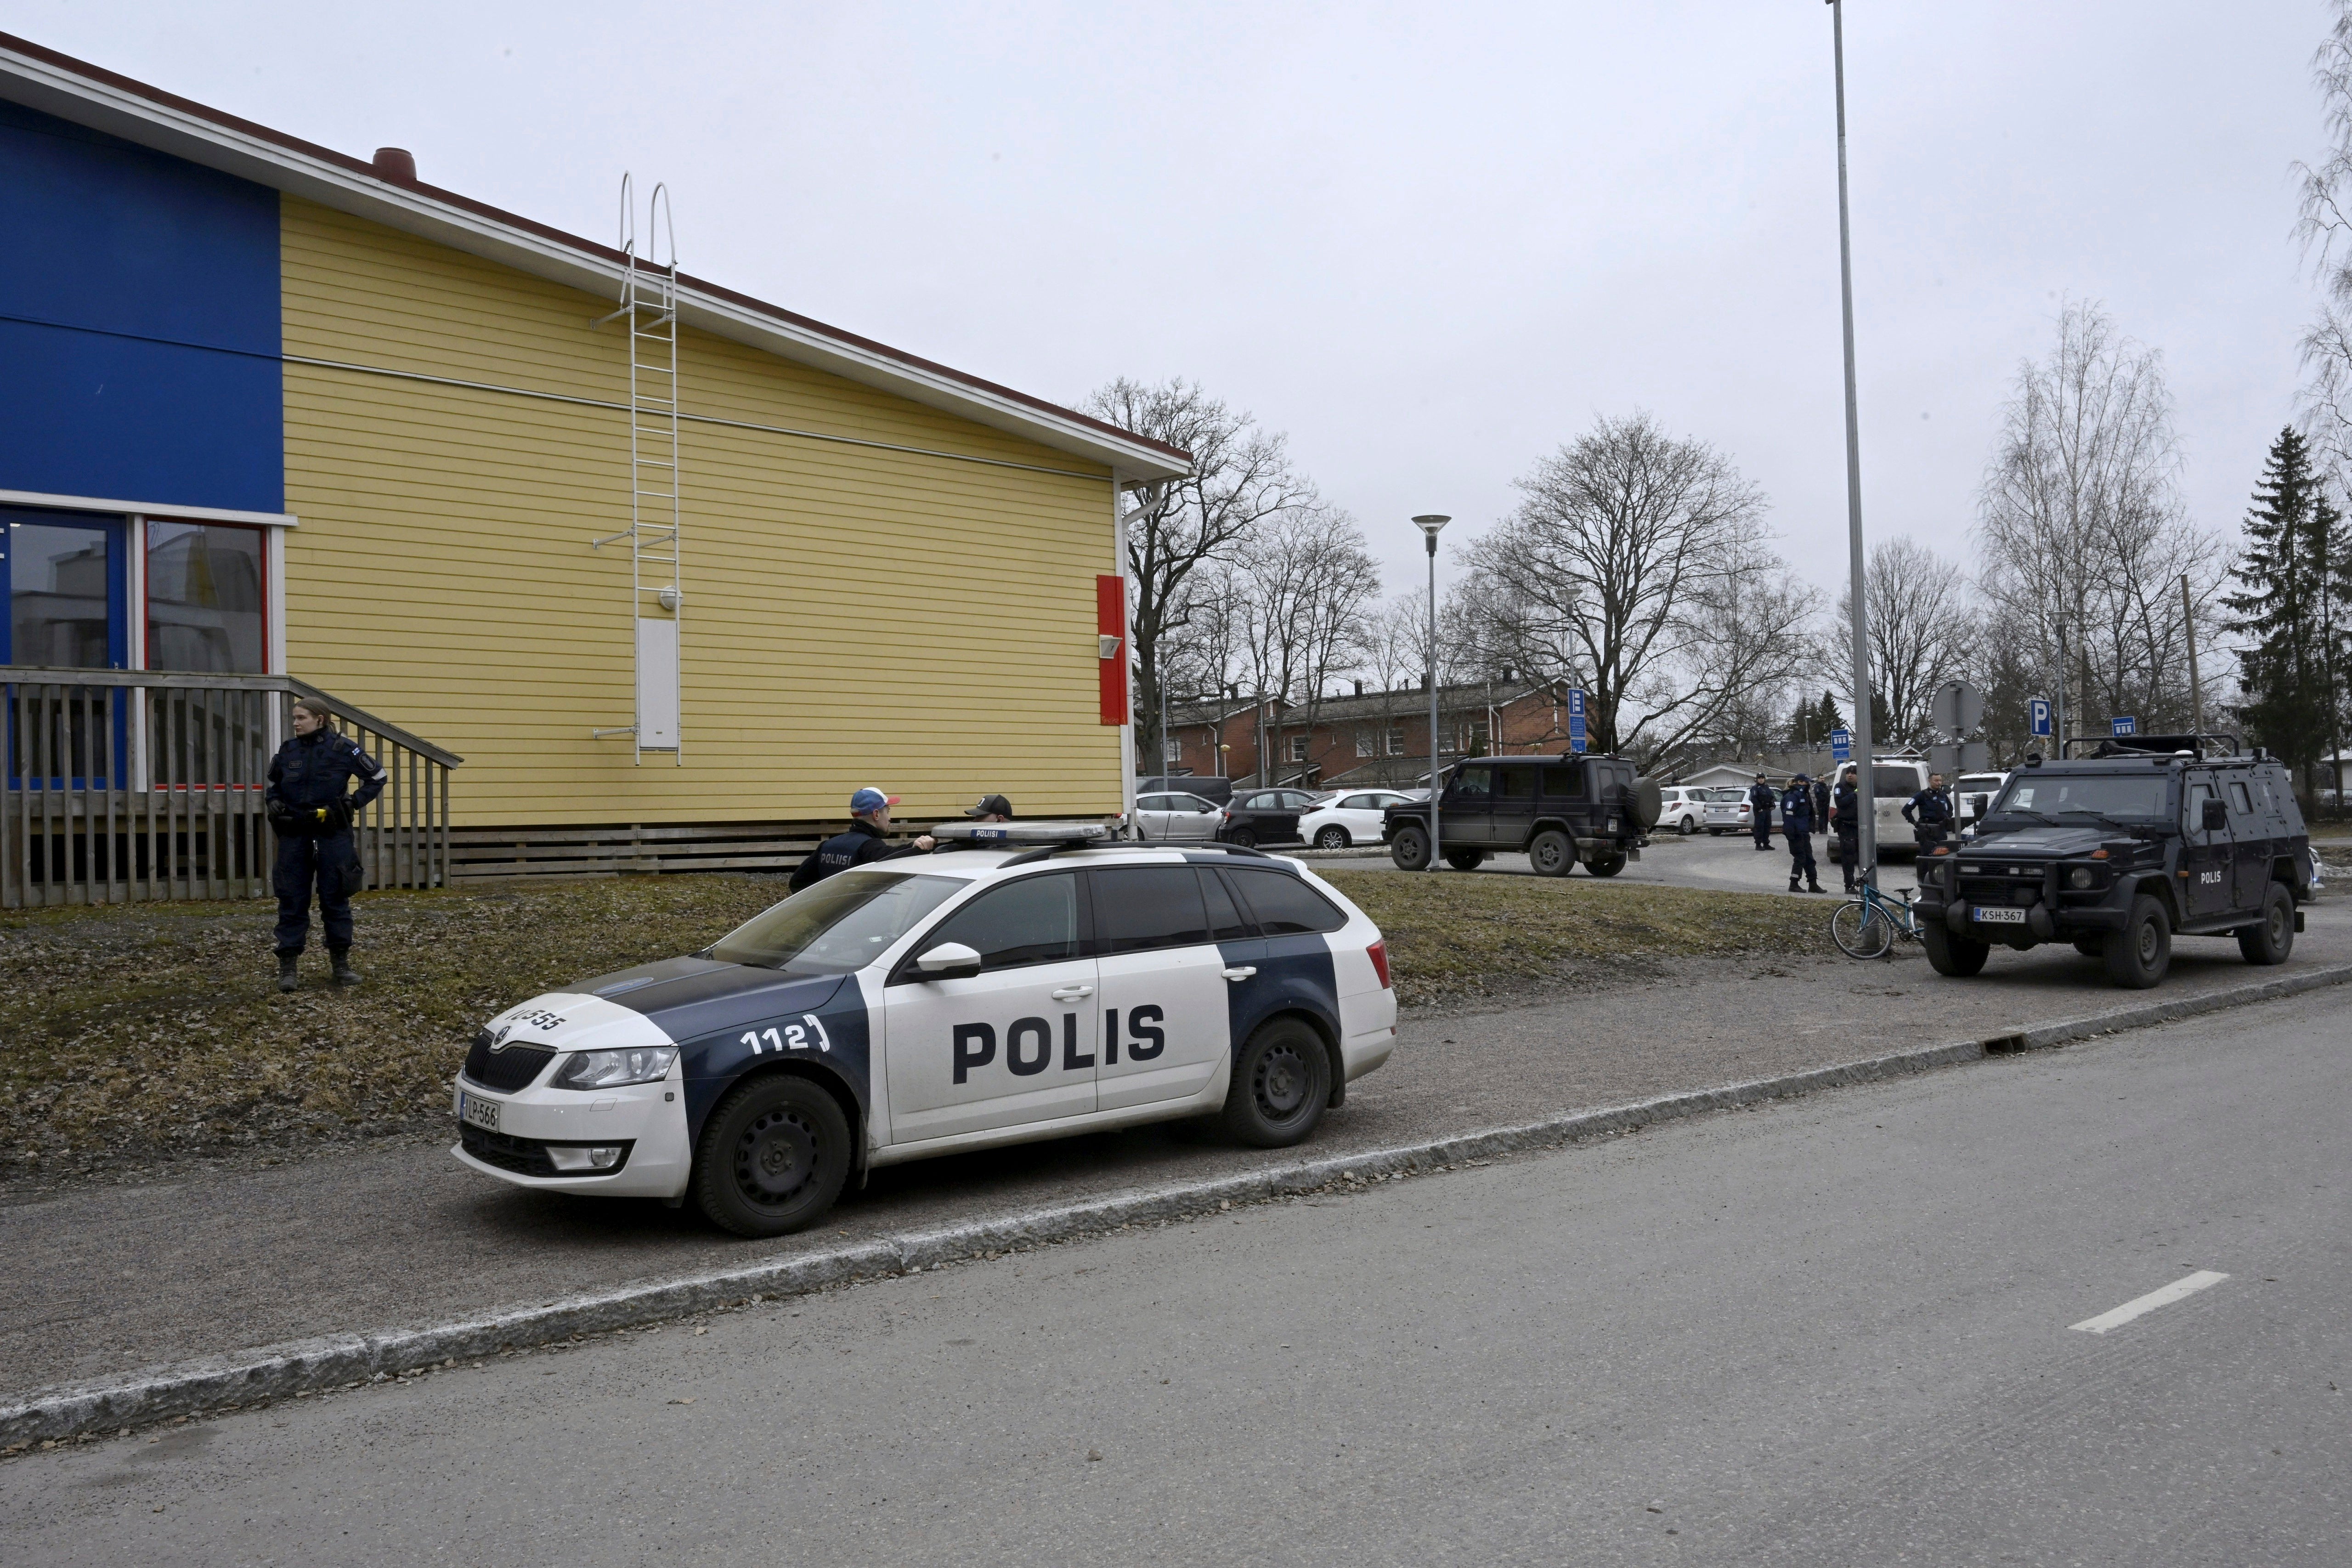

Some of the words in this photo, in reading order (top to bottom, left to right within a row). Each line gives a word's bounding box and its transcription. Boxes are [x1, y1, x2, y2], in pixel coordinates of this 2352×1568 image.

[2035, 702, 2047, 732] P
[820, 853, 851, 866] POLIISI
[2201, 871, 2221, 884] POLIS
[1982, 911, 2022, 921] KSH-367
[740, 1025, 808, 1055] 112
[953, 1004, 1165, 1085] POLIS
[465, 1098, 496, 1126] ILP-566
